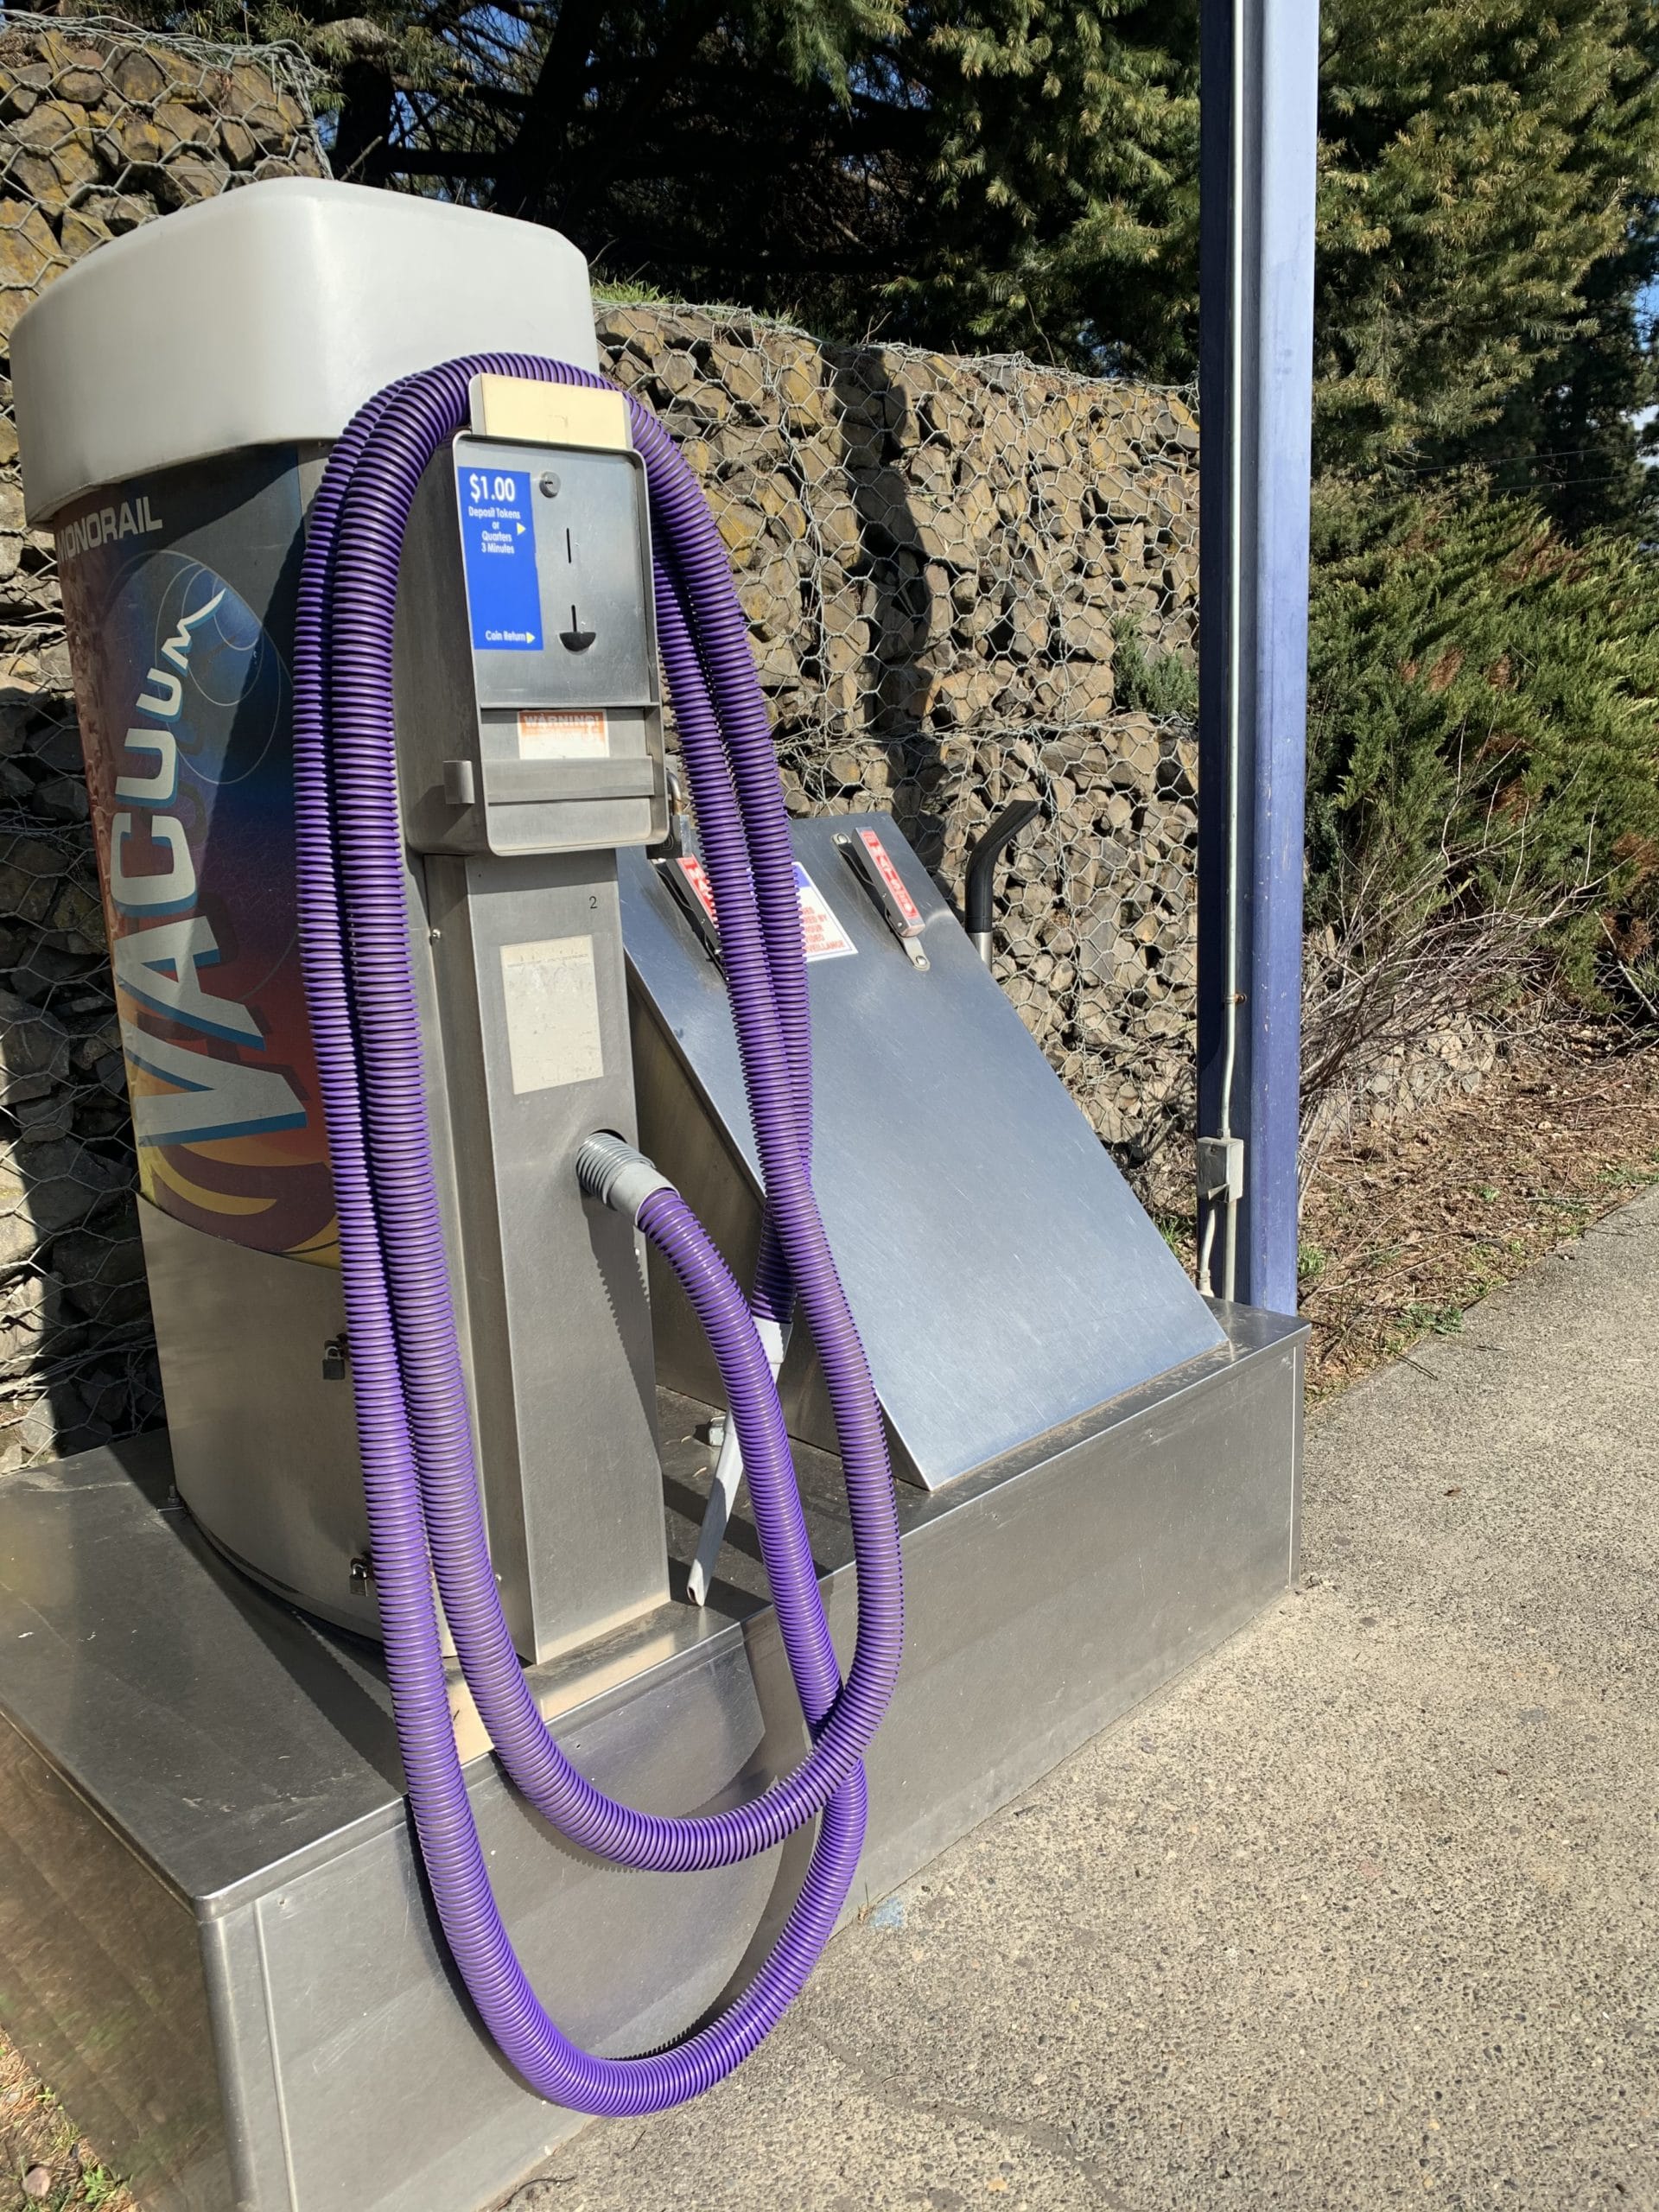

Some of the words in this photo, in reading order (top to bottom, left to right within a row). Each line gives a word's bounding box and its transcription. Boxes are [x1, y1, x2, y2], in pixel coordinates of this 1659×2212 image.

[469, 473, 516, 504] $1.00
[467, 505, 496, 520] Deposit
[496, 506, 521, 519] Tokens
[57, 496, 163, 563] MONORAIL
[492, 521, 500, 530] or
[481, 530, 512, 542] Quarters
[481, 542, 487, 553] 3
[487, 542, 515, 554] Minutes
[485, 630, 503, 641] Coin
[503, 630, 526, 641] Return
[110, 588, 307, 1147] VACUUM
[588, 895, 598, 909] 2
